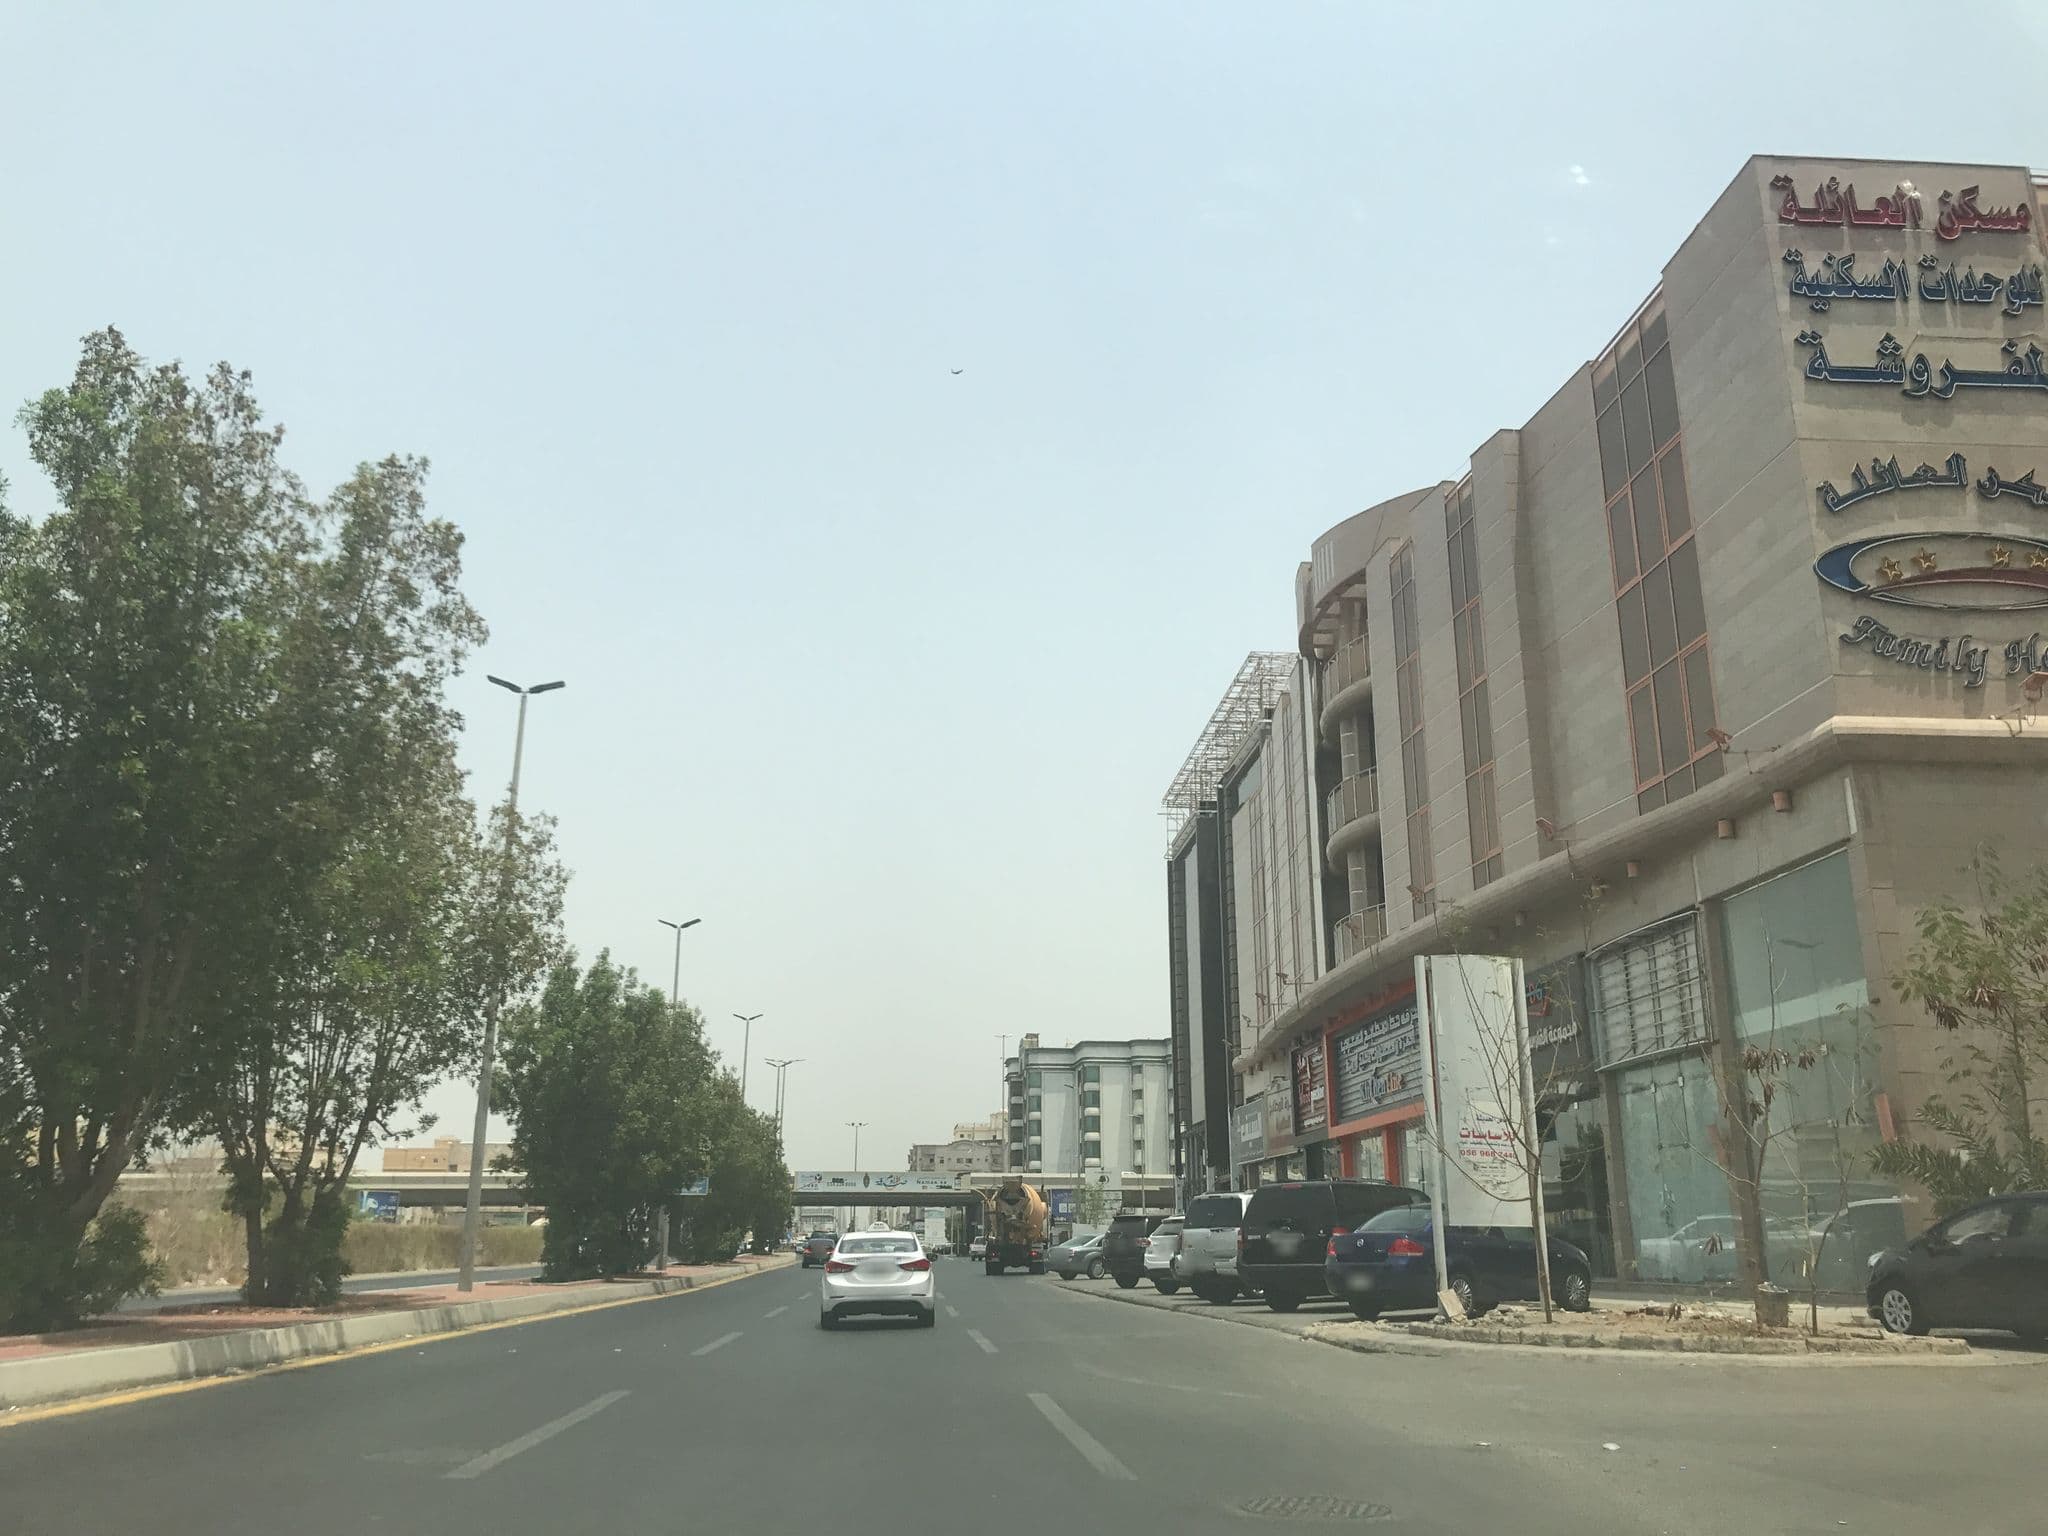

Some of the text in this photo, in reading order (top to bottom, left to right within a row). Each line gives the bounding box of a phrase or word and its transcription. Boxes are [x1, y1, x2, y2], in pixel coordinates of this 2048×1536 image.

[1770, 174, 2032, 239] مسكن العائلة
[1782, 247, 1911, 314] السكنية
[1815, 450, 1968, 512] العائلة
[1838, 615, 1989, 688] Family
